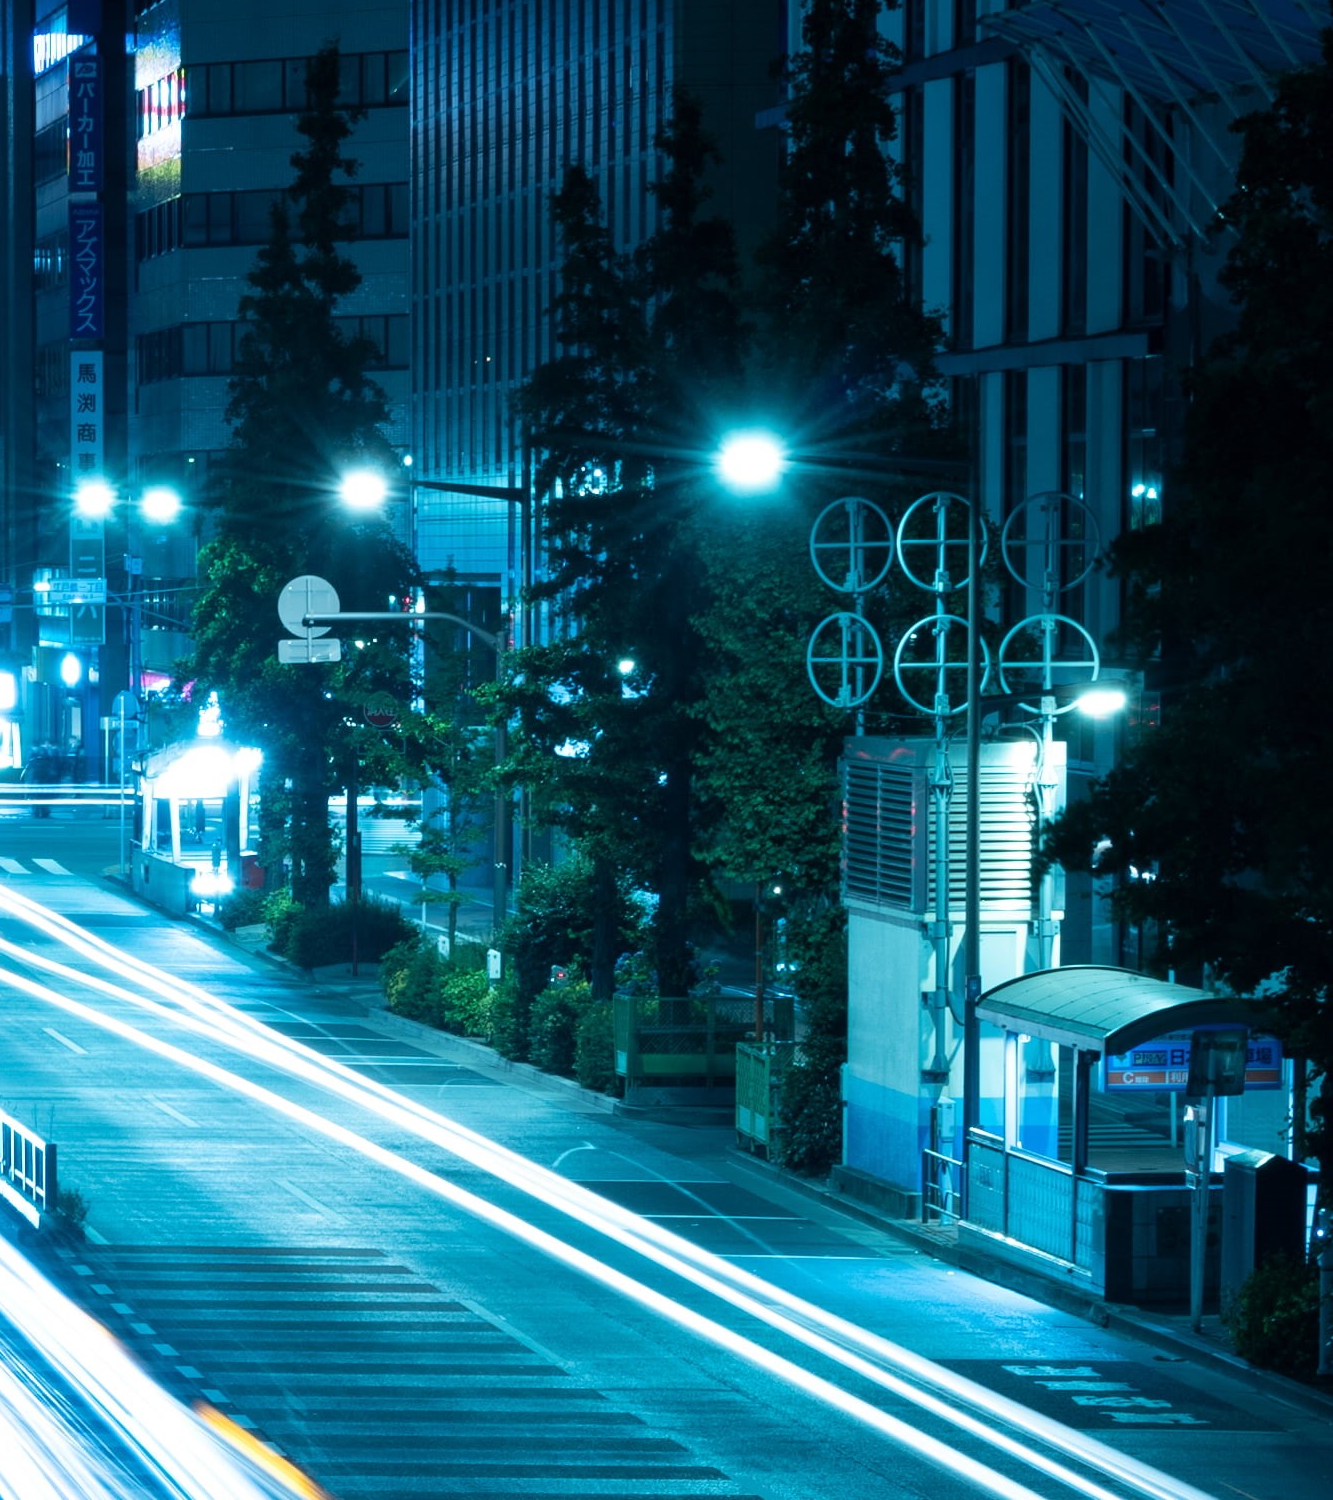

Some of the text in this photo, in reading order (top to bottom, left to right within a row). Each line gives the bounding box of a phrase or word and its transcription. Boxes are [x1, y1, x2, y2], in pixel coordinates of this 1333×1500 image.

[75, 81, 98, 190] パーカー加工
[74, 219, 99, 332] アズマックス
